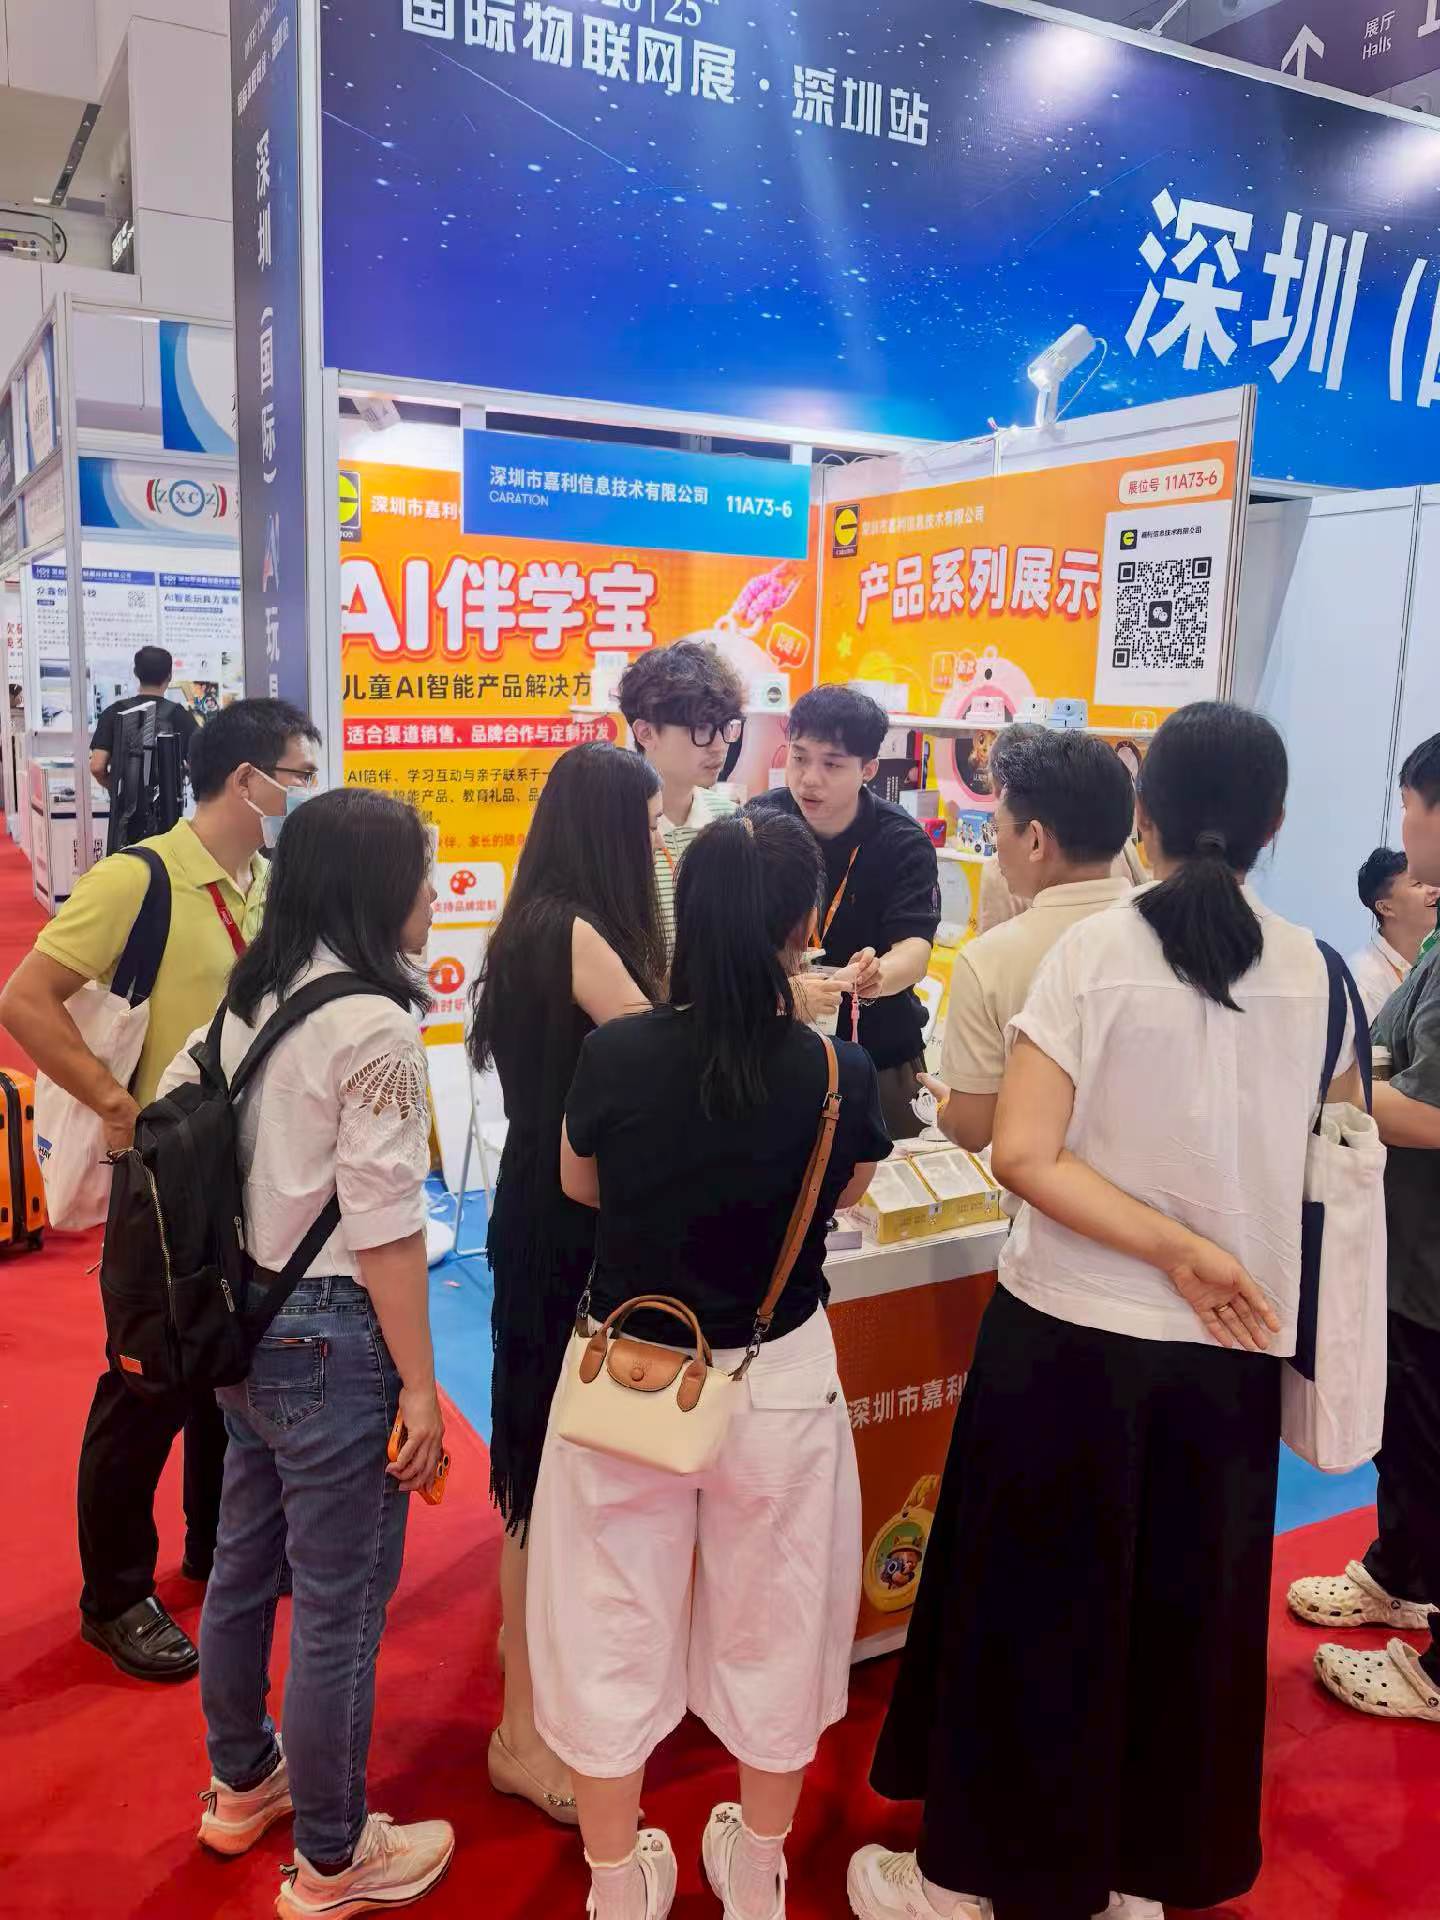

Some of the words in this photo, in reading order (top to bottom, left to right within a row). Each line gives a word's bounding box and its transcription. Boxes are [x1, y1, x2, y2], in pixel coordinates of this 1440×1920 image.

[1364, 10, 1396, 39] 展厅
[1362, 36, 1392, 60] Halls
[490, 464, 708, 504] 深圳市嘉利信息技术有限公司
[1128, 477, 1160, 495] 展位号
[1165, 470, 1218, 490] 11A73-6
[371, 495, 462, 520] 深圳市嘉利
[489, 489, 549, 507] CARATION
[726, 495, 793, 518] 11A73-6
[858, 546, 1100, 625] 产品系列展示
[340, 558, 656, 651] AI伴学宝
[343, 672, 591, 700] 儿童AI智能产品解决方
[347, 722, 610, 746] 适合渠道销售、品牌合作与定制开发
